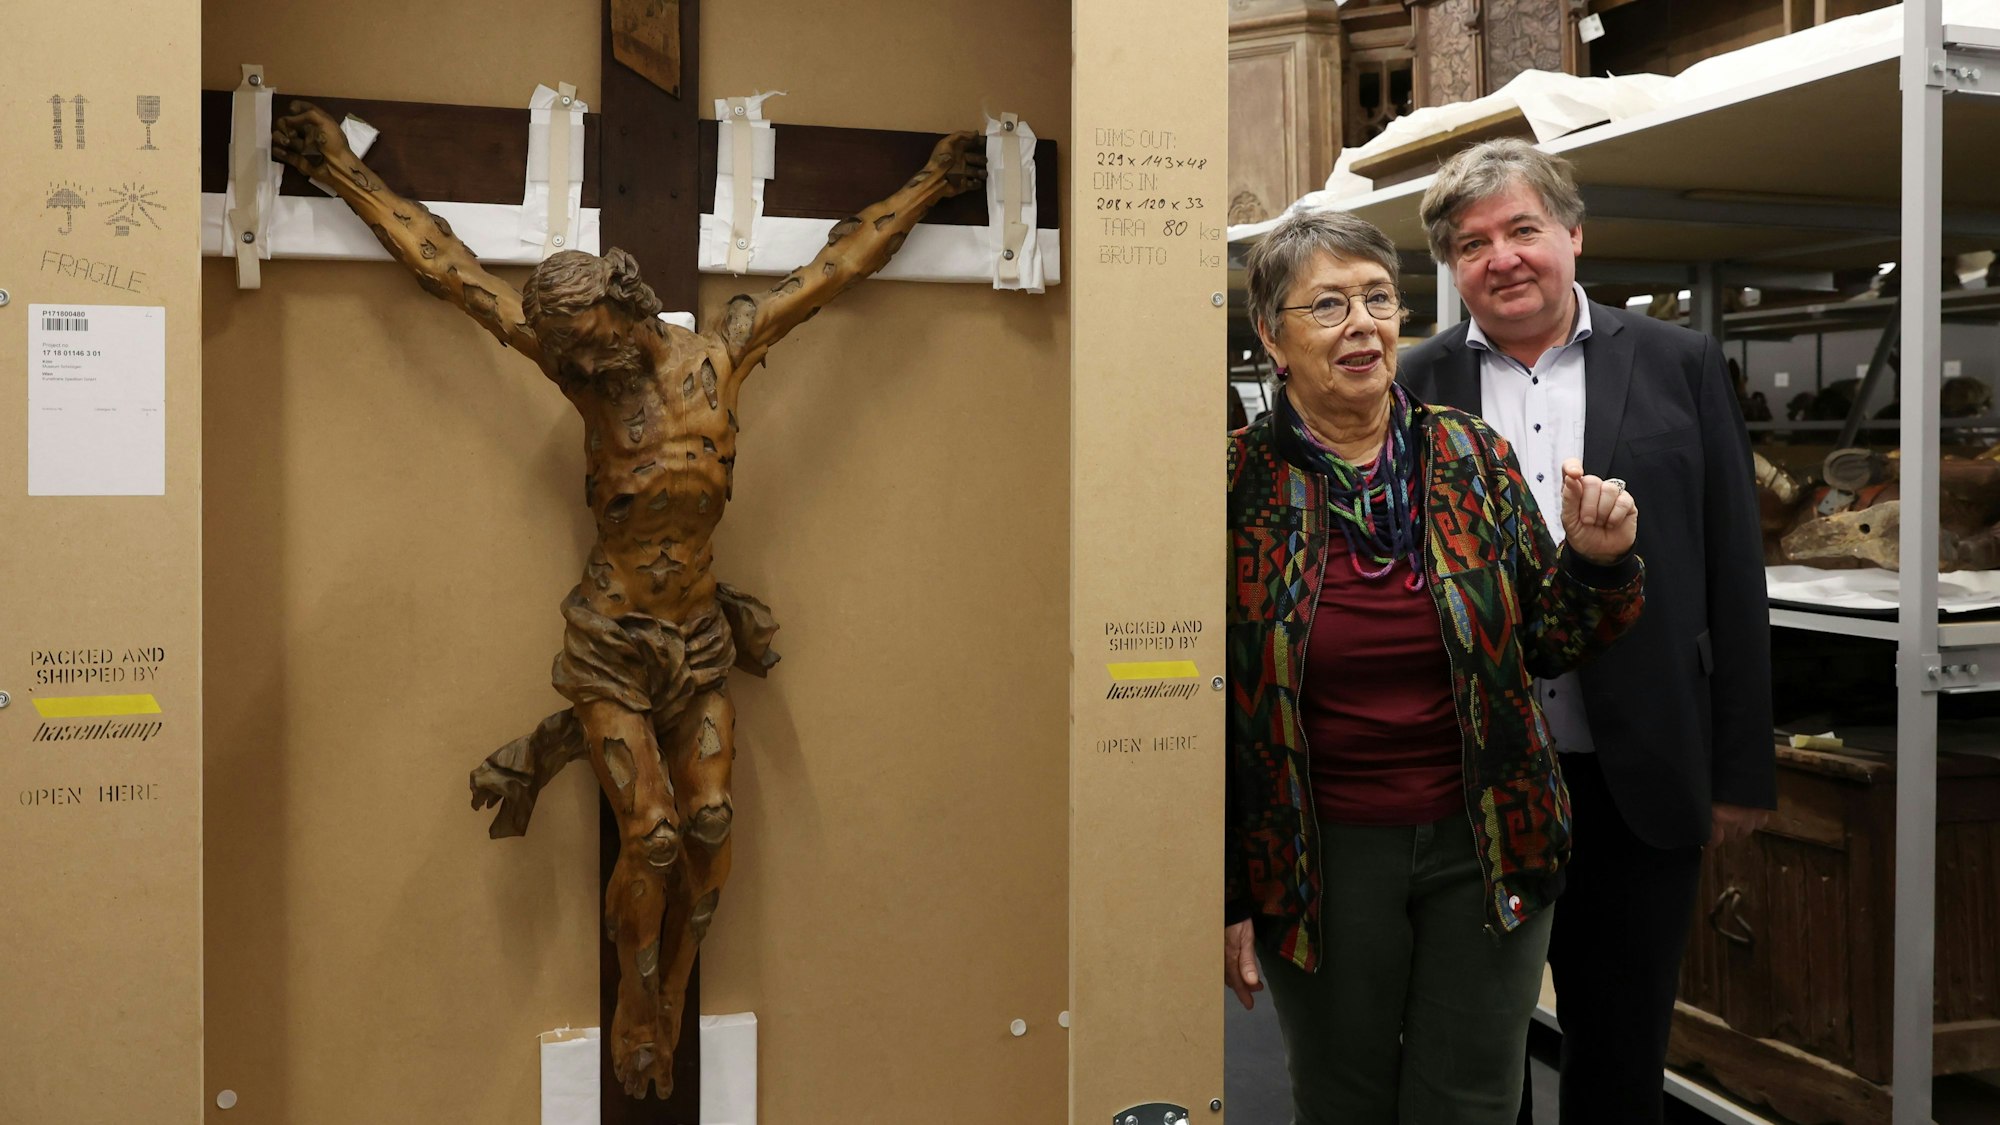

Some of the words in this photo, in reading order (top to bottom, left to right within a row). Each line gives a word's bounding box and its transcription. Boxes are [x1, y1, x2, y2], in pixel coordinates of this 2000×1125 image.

[1095, 127, 1135, 148] DIMS
[1139, 129, 1177, 150] OUT:
[1096, 152, 1124, 167] 229
[1093, 171, 1134, 191] DIMS
[1138, 172, 1158, 191] IN:
[1096, 197, 1120, 211] 208
[1125, 200, 1133, 209] x
[1137, 197, 1166, 210] 120
[1171, 201, 1179, 211] x
[1185, 197, 1204, 210] 33
[1099, 217, 1146, 237] TARA
[1162, 219, 1188, 237] 80
[1199, 221, 1221, 241] kg
[1098, 245, 1167, 266] BRUTTO
[1199, 248, 1221, 268] kg
[40, 250, 147, 294] FRAGILE
[42, 310, 86, 318] P171800480
[1105, 621, 1166, 636] PACKED
[1171, 620, 1203, 634] AND
[1109, 637, 1174, 651] SHIPPED
[1179, 636, 1198, 649] BY
[30, 649, 113, 666] PACKED
[122, 647, 165, 663] AND
[36, 667, 125, 685] SHIPPED
[133, 666, 158, 681] BY
[1106, 681, 1200, 700] hasenkamp
[32, 719, 163, 742] hasenkamp
[1096, 737, 1142, 754] OPEN
[1153, 735, 1198, 751] HERE
[19, 786, 82, 806] OPEN
[99, 783, 159, 802] HERE
